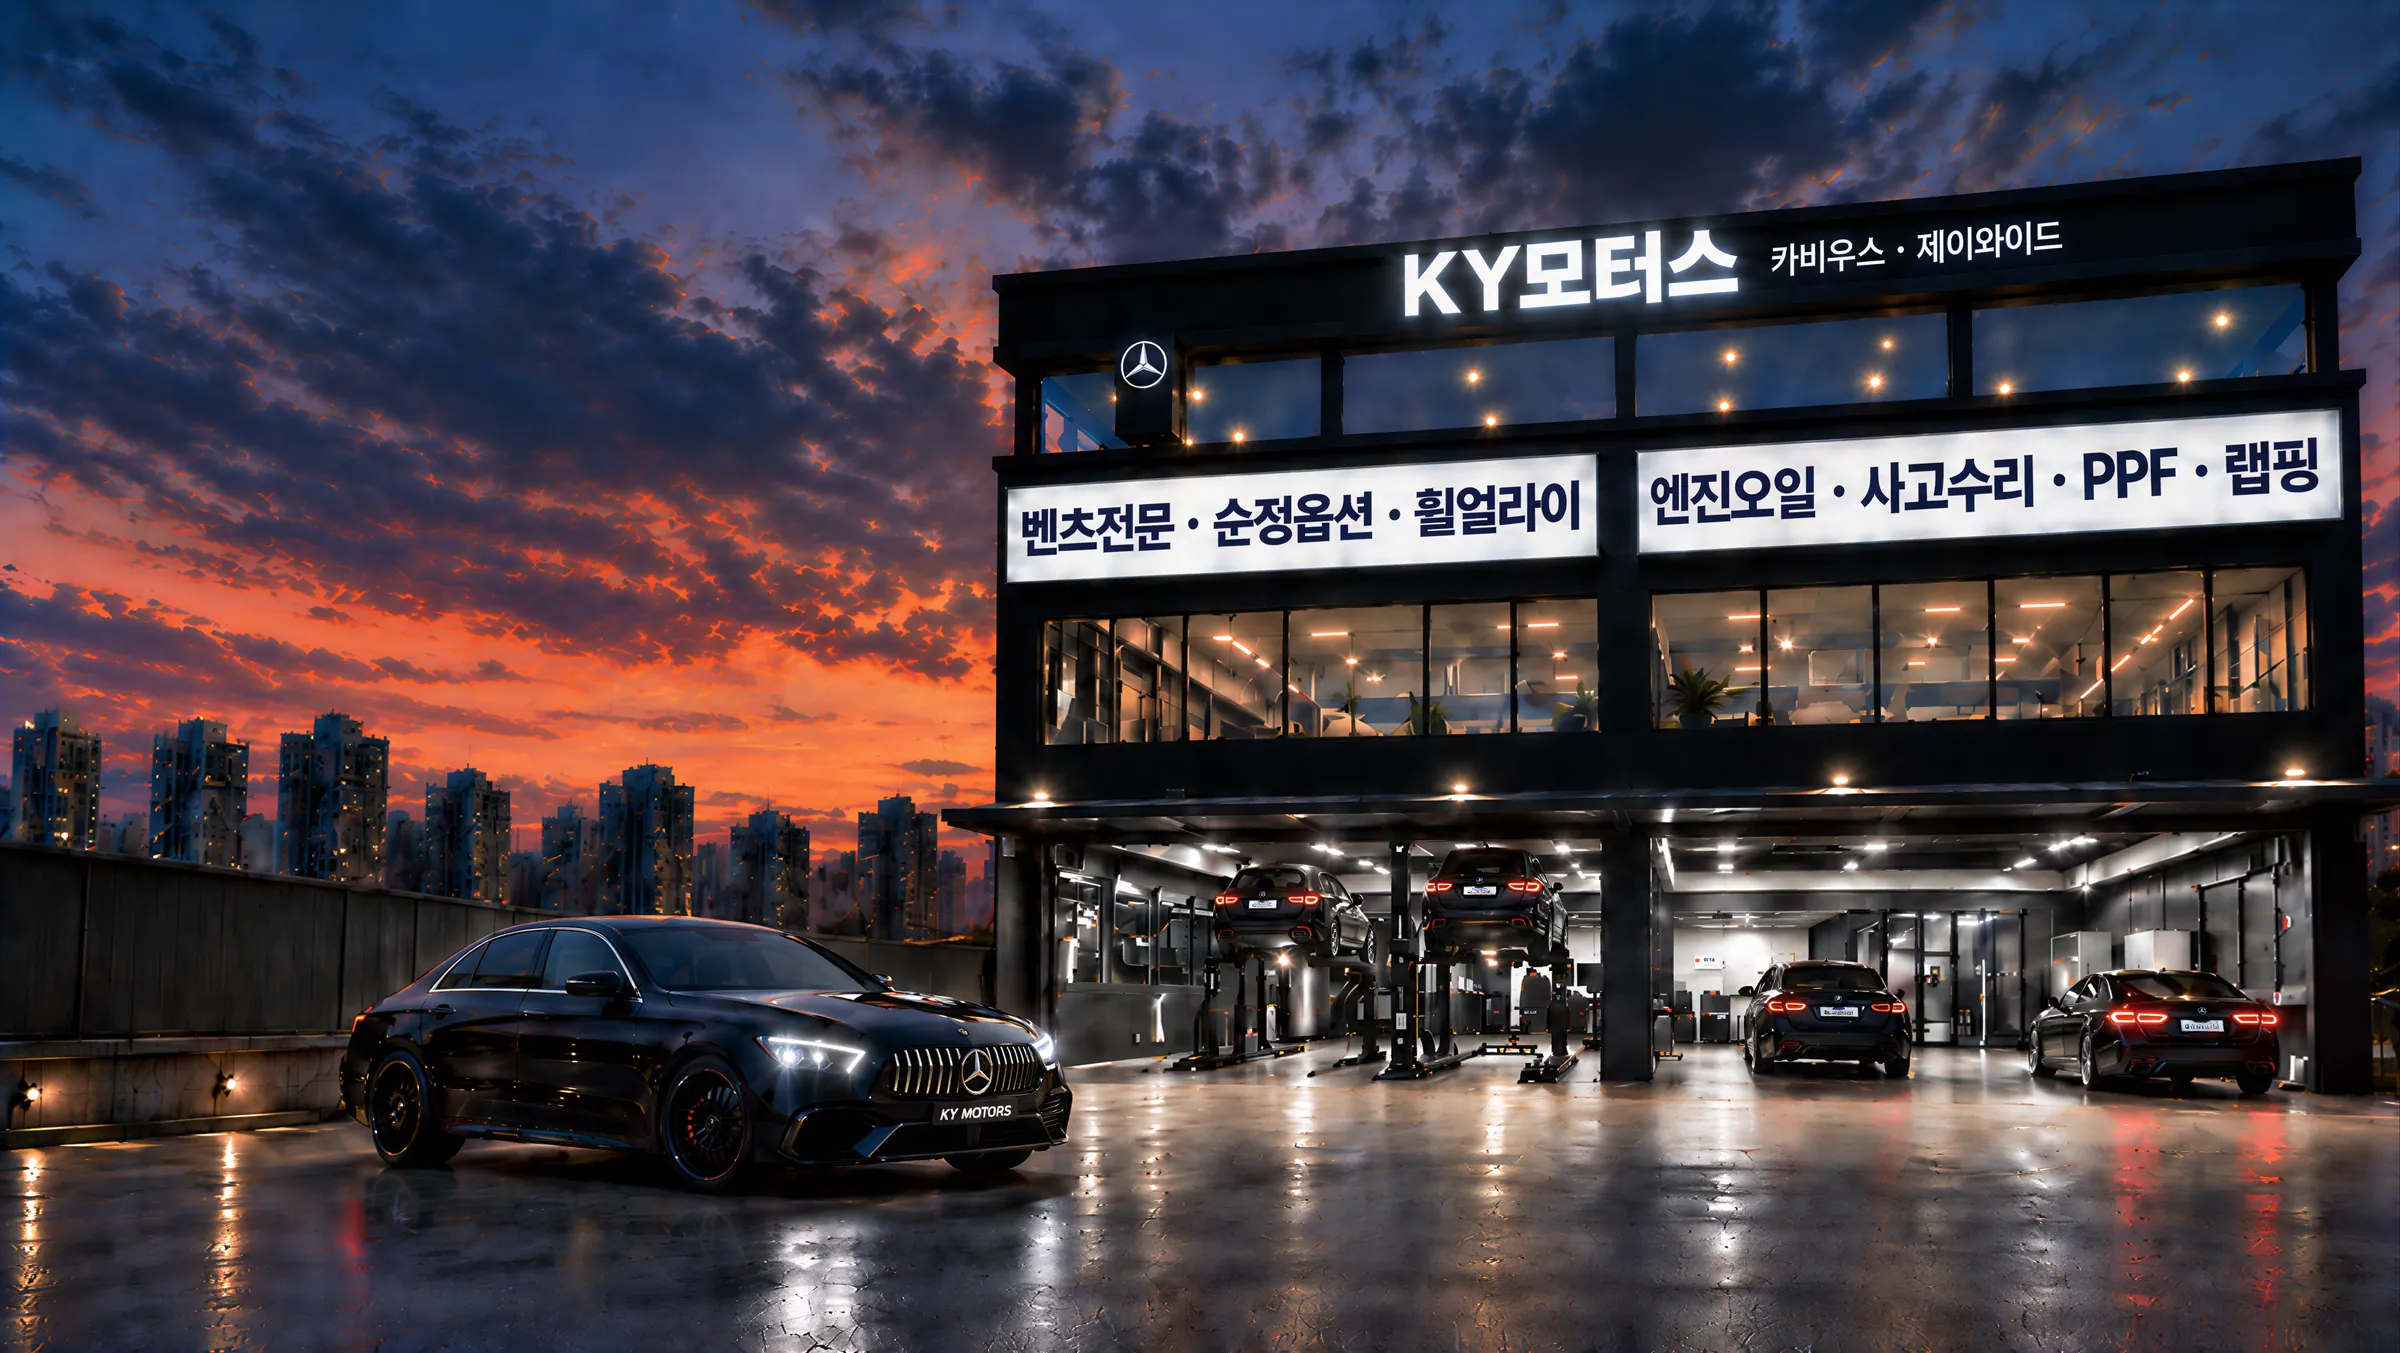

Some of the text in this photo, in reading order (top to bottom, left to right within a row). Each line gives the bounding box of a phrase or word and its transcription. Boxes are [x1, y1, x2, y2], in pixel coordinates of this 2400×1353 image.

[1403, 229, 1739, 318] KY모터스
[1770, 236, 1886, 276] 카비우스
[1916, 220, 2064, 264] 제이와이드
[1021, 502, 1175, 557] 벤츠전문
[1213, 490, 1373, 548] 순정옵션
[1414, 479, 1580, 538] 휠얼라이
[1650, 465, 1816, 526] 엔진오일
[1860, 454, 2034, 514] 사고수리
[2083, 446, 2178, 501] PPF
[2225, 436, 2319, 496] 랩핑
[939, 1105, 1012, 1121] KY MOTORS
